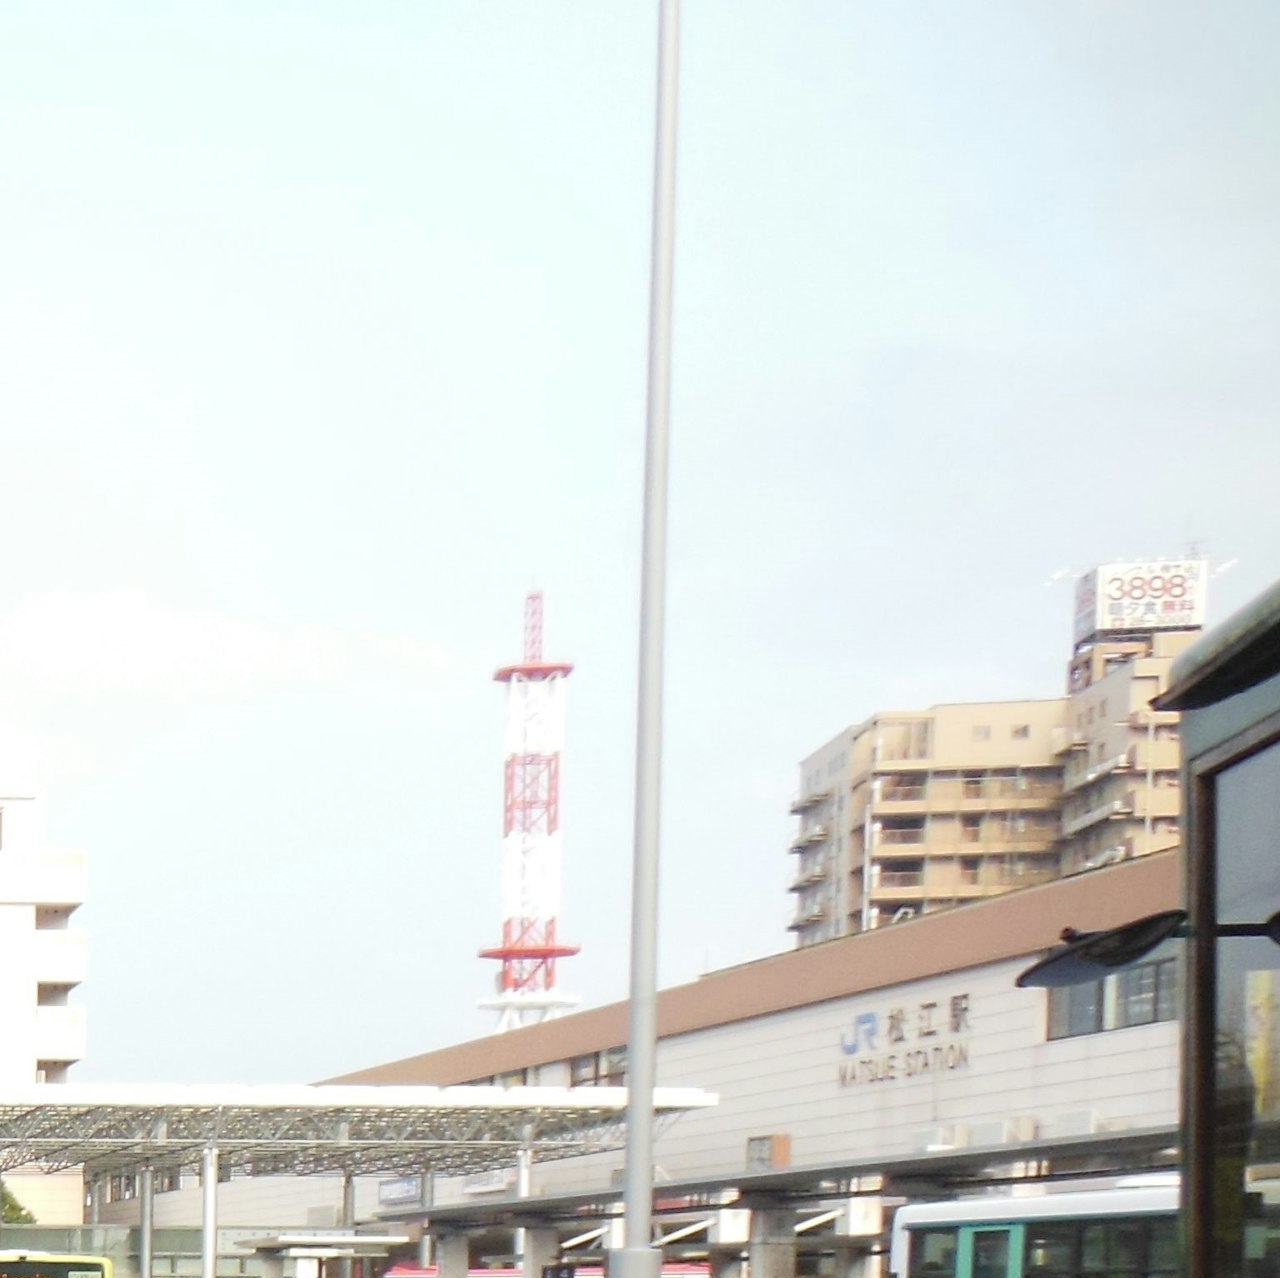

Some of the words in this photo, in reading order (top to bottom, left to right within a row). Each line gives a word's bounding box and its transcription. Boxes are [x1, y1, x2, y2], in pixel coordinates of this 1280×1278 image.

[1108, 574, 1186, 601] 3898
[840, 1011, 879, 1055] JR
[887, 993, 970, 1042] 松江駅
[904, 1042, 968, 1077] STATION
